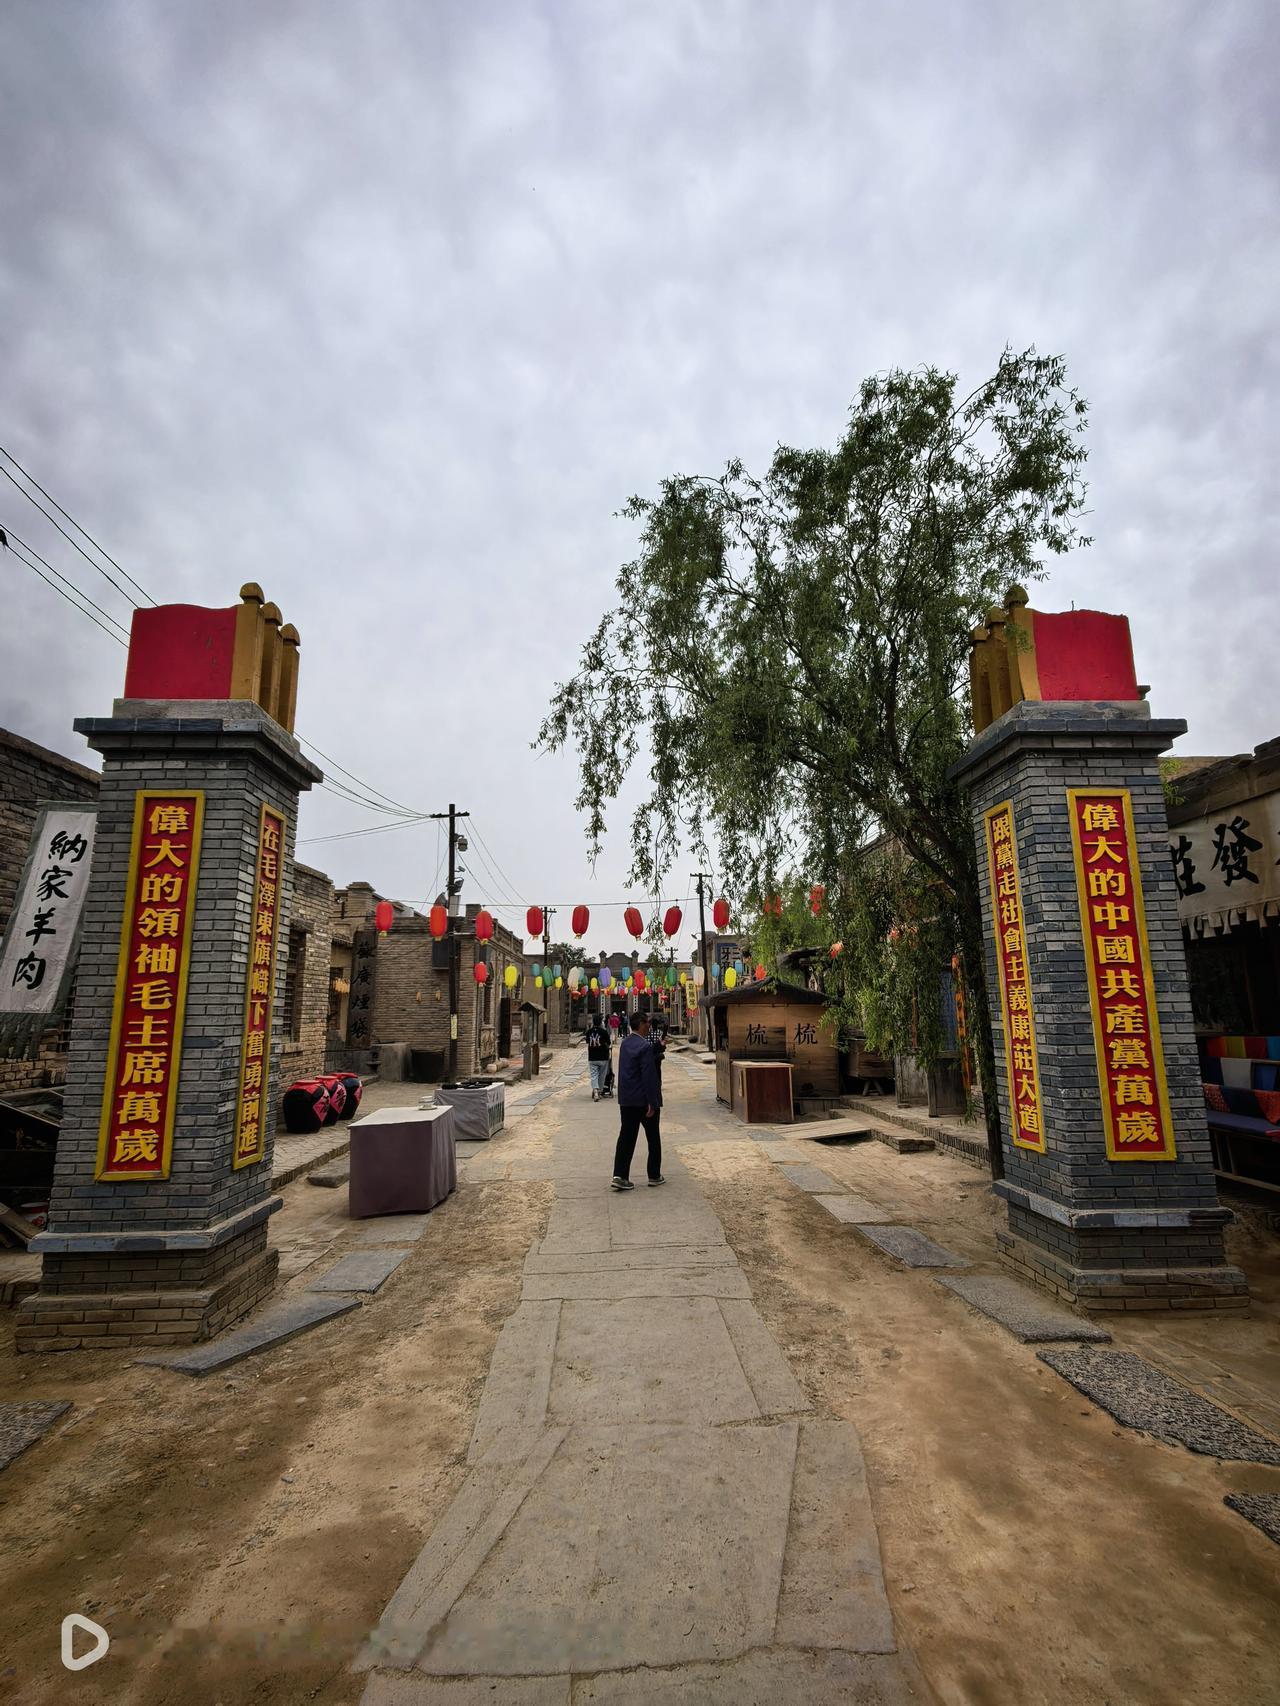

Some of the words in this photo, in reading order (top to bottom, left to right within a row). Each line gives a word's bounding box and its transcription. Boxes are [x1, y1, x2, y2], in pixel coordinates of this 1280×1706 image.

[12, 830, 88, 990] 納家羊肉
[113, 805, 190, 1164] 偉大的領袖毛主席萬歲
[1081, 803, 1159, 1144] 偉大的中國共產黨萬歲
